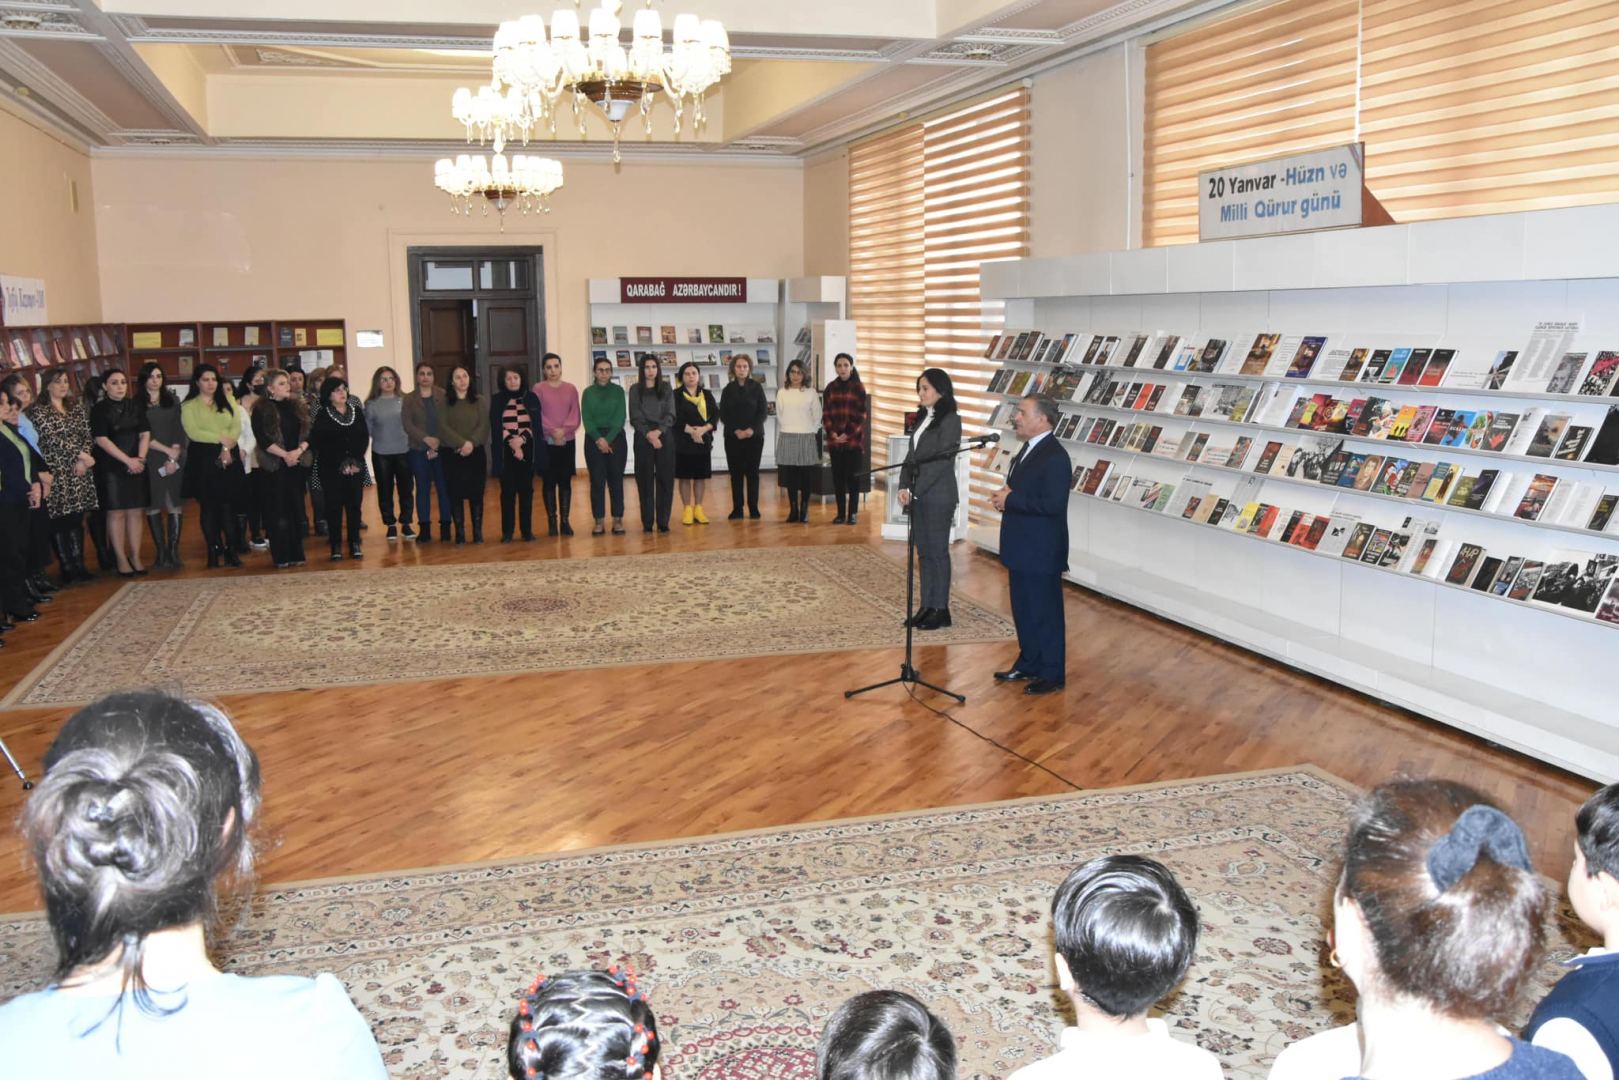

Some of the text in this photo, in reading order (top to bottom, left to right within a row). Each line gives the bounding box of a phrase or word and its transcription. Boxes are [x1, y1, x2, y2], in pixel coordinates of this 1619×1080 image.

[1208, 177, 1225, 199] 20
[1229, 174, 1276, 194] Yanvar
[1330, 162, 1347, 179] və
[1220, 190, 1341, 222] Milli Qürur günü
[626, 281, 666, 297] QARABAĞ
